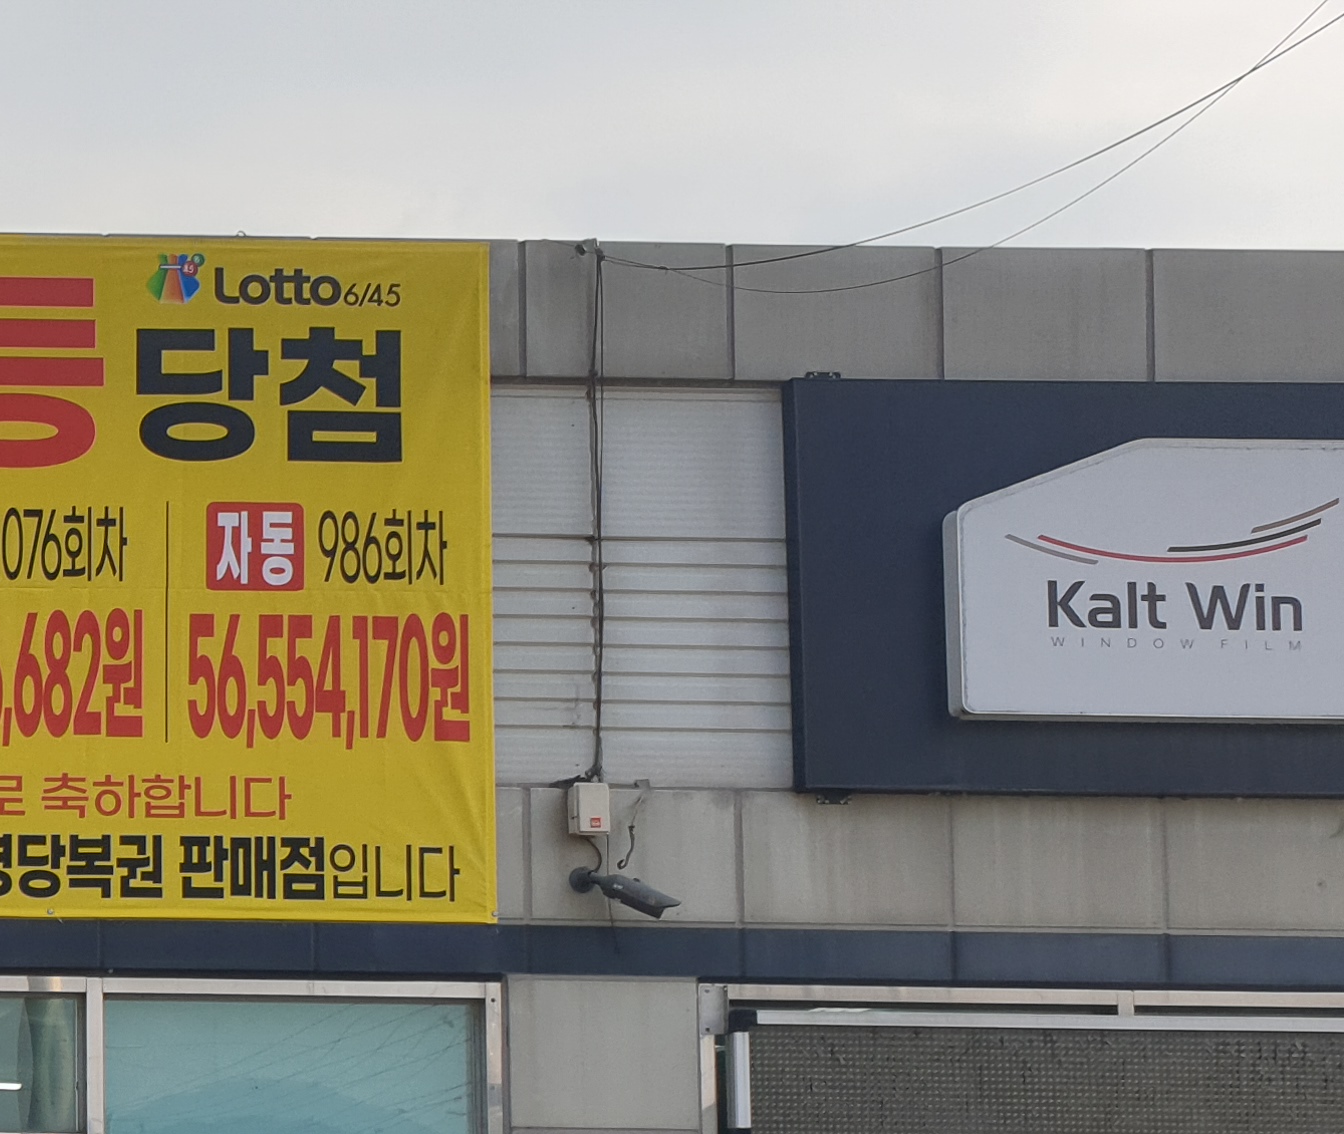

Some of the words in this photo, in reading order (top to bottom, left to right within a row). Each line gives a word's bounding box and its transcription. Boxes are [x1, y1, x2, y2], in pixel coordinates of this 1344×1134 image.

[136, 326, 403, 463] 당첨
[216, 510, 295, 586] 자동
[318, 508, 448, 586] 986회차
[1047, 580, 1167, 630] Kalt
[1185, 582, 1304, 632] Win
[1050, 635, 1195, 651] WINDOW
[1220, 637, 1303, 652] FILM
[187, 611, 471, 750] 56,554,170원
[41, 773, 292, 821] 축하합니다
[178, 835, 461, 902] 판매점입니다
